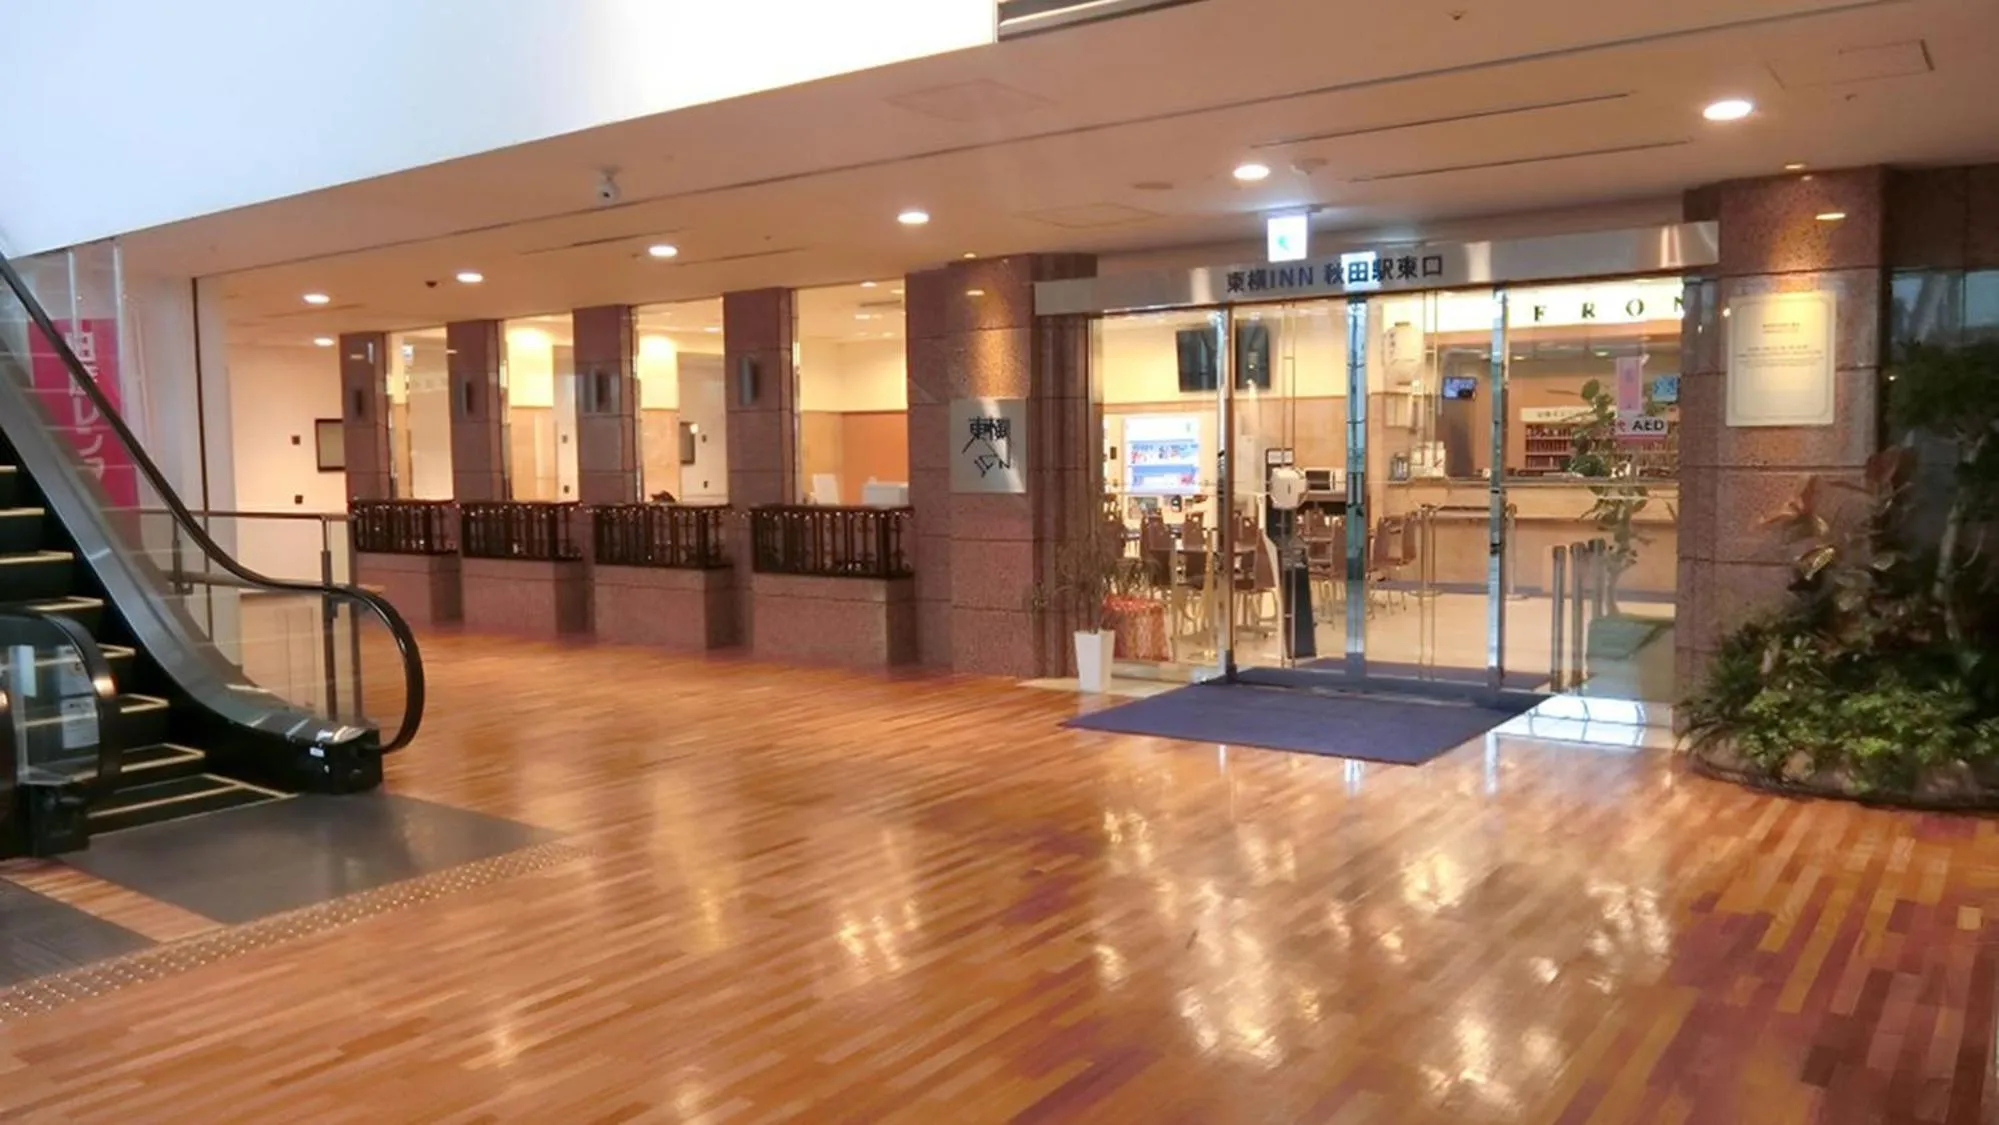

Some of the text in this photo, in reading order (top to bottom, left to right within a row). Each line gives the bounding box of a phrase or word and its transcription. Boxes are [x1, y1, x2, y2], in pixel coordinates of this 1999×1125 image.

[1227, 255, 1443, 293] 東横INN 秋田駅東口
[1632, 420, 1664, 432] AED
